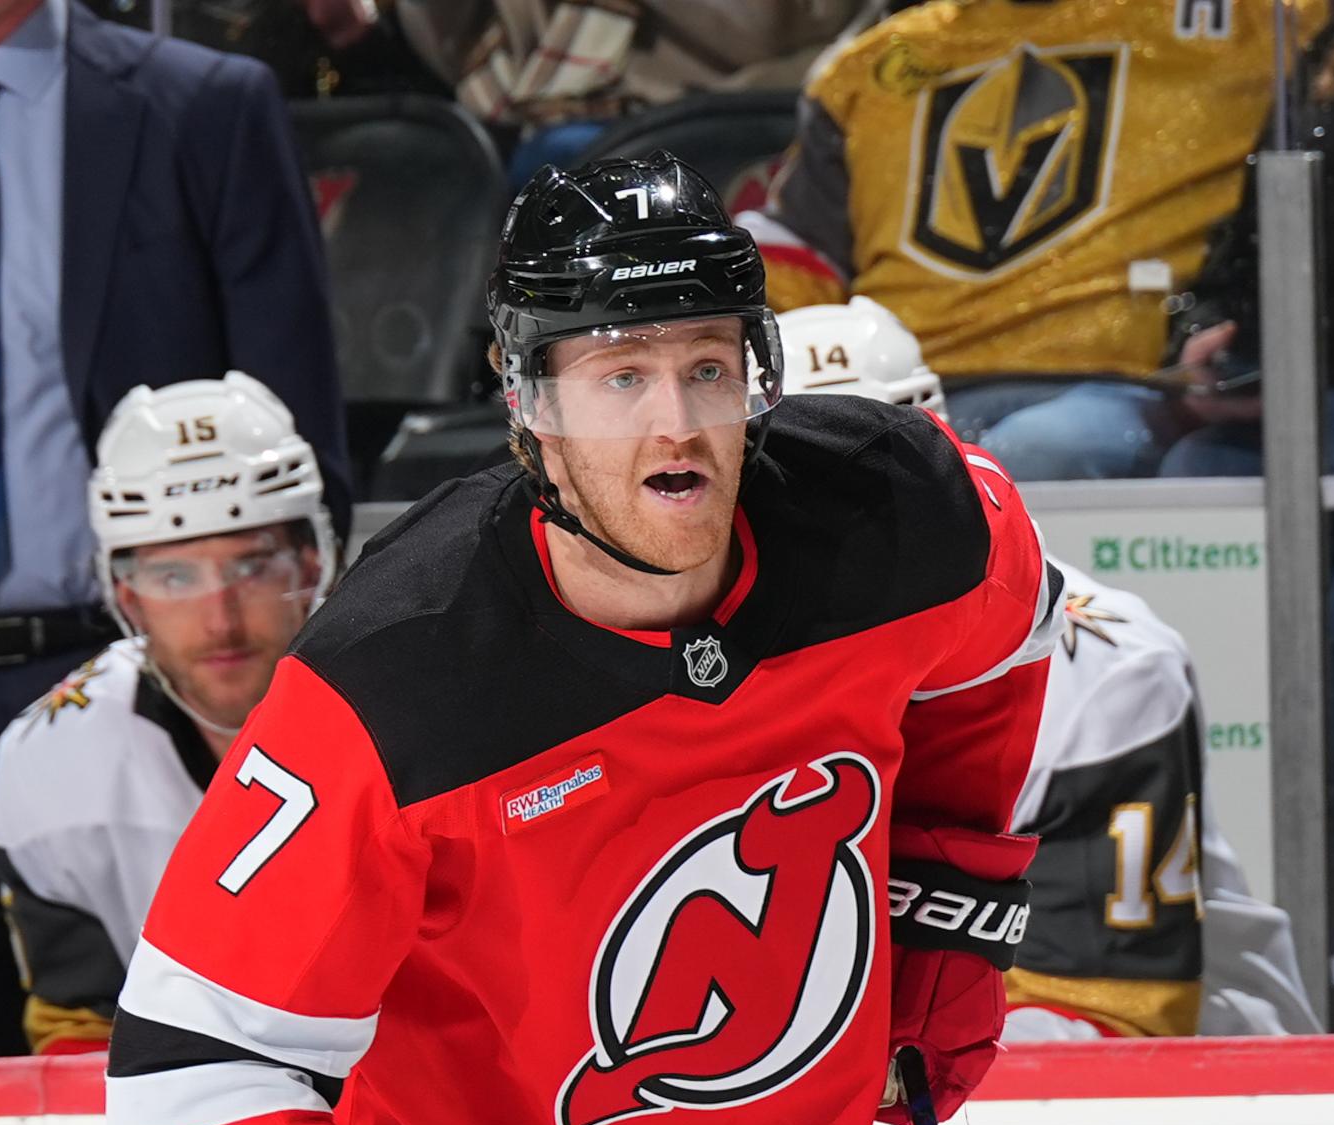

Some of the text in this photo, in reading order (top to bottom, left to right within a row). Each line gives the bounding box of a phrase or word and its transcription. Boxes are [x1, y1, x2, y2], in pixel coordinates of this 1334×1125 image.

[614, 187, 650, 220] 7
[611, 258, 698, 282] BAUER
[806, 342, 850, 372] 14
[175, 415, 219, 445] 15
[163, 474, 240, 498] CCM
[1129, 536, 1260, 571] Citizens
[697, 650, 717, 679] NHL
[216, 744, 319, 897] 7
[522, 796, 564, 821] HEALTH
[1104, 792, 1207, 929] 14
[887, 877, 1030, 945] BAUE
